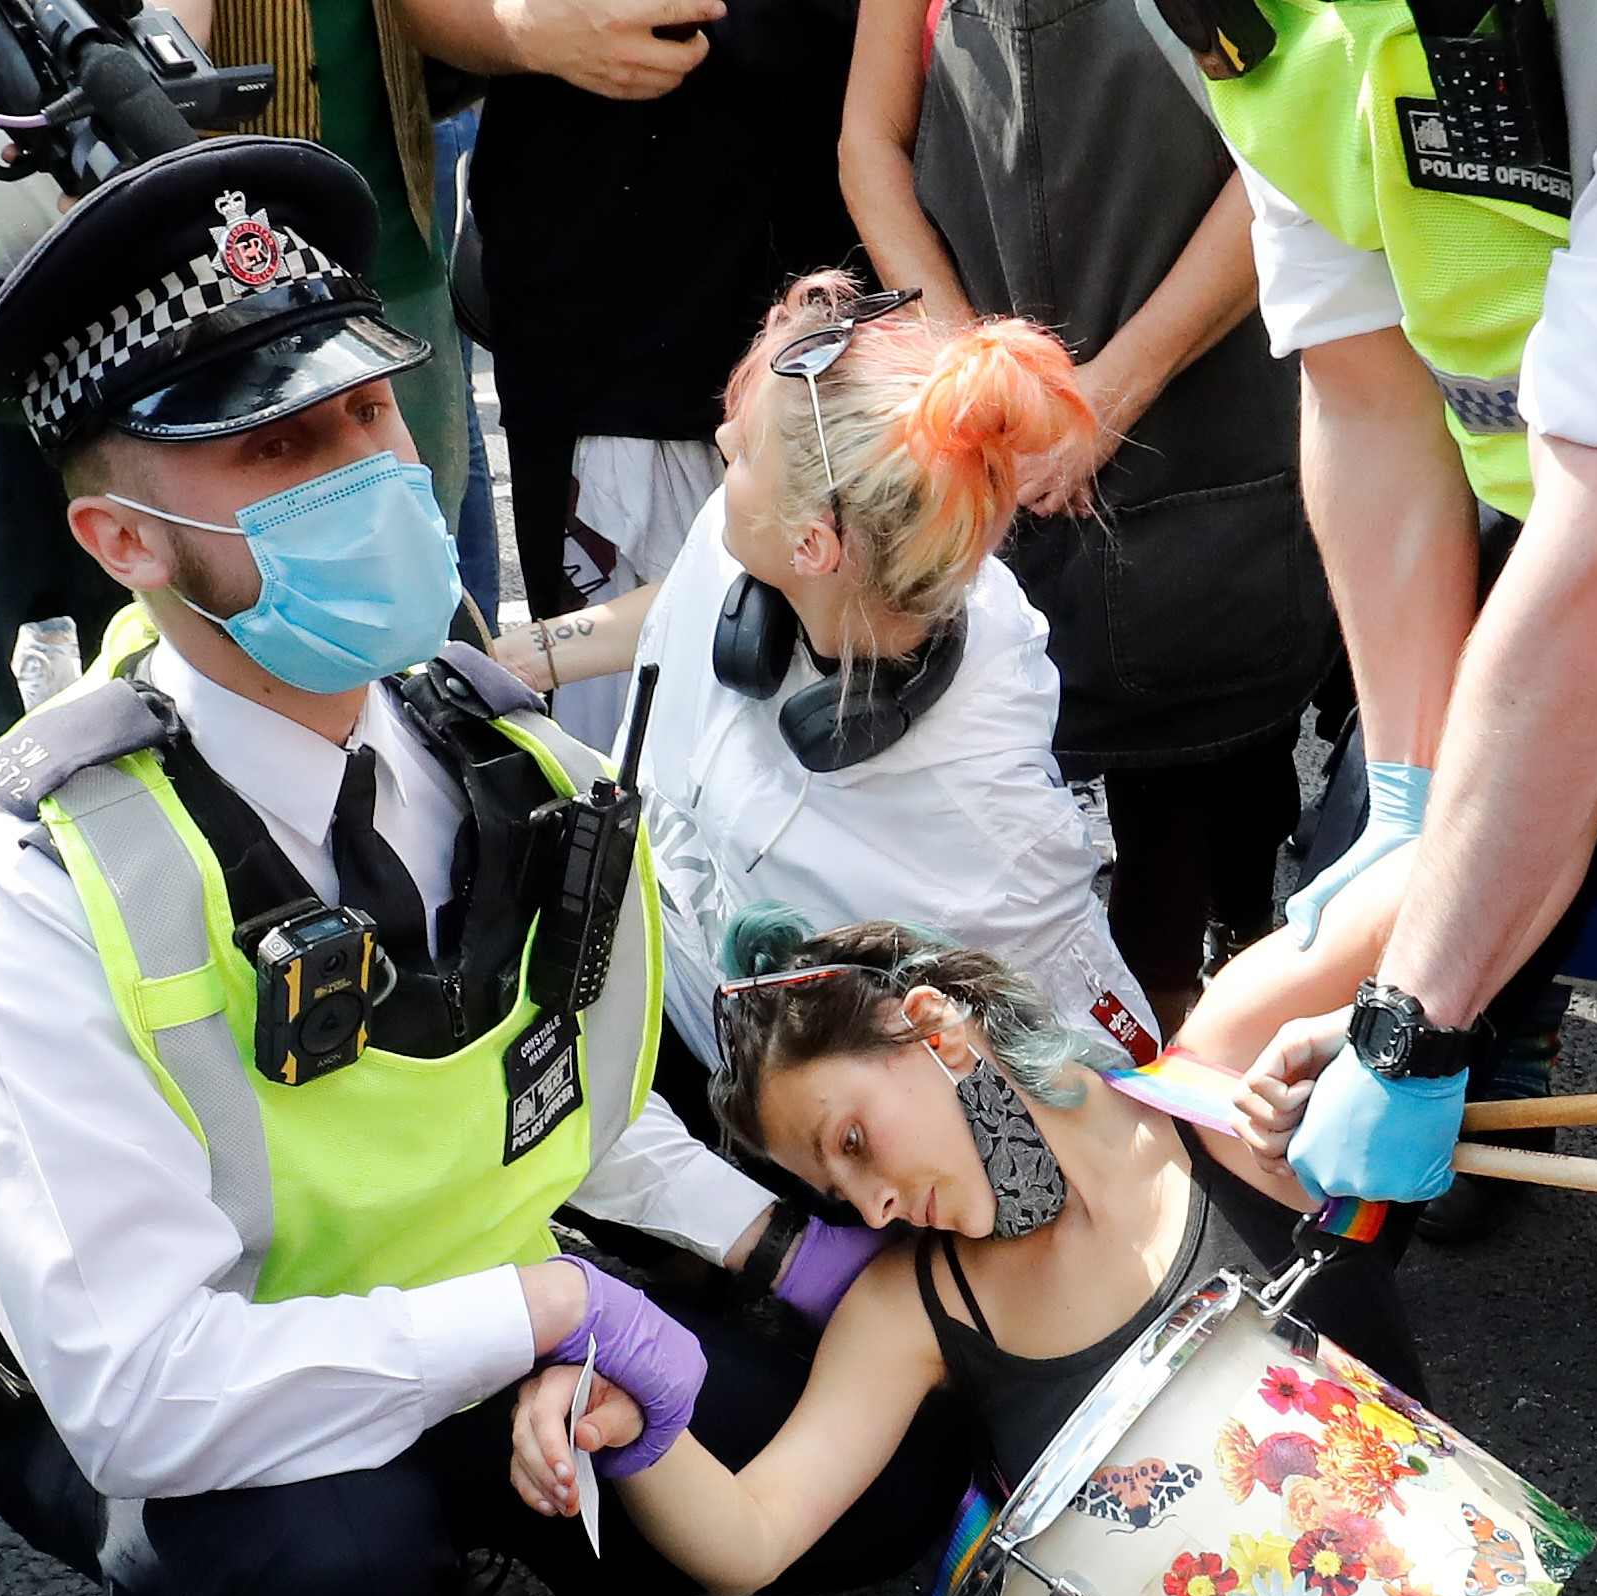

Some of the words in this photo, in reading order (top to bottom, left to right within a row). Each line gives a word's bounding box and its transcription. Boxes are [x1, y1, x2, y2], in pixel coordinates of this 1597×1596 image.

[1419, 158, 1491, 183] POLICE
[1495, 165, 1572, 201] OFFICER
[10, 736, 50, 768] SW
[520, 1014, 562, 1059] CONSTABLE
[512, 1115, 545, 1151] POLICE
[544, 1084, 575, 1124] OFFICER
